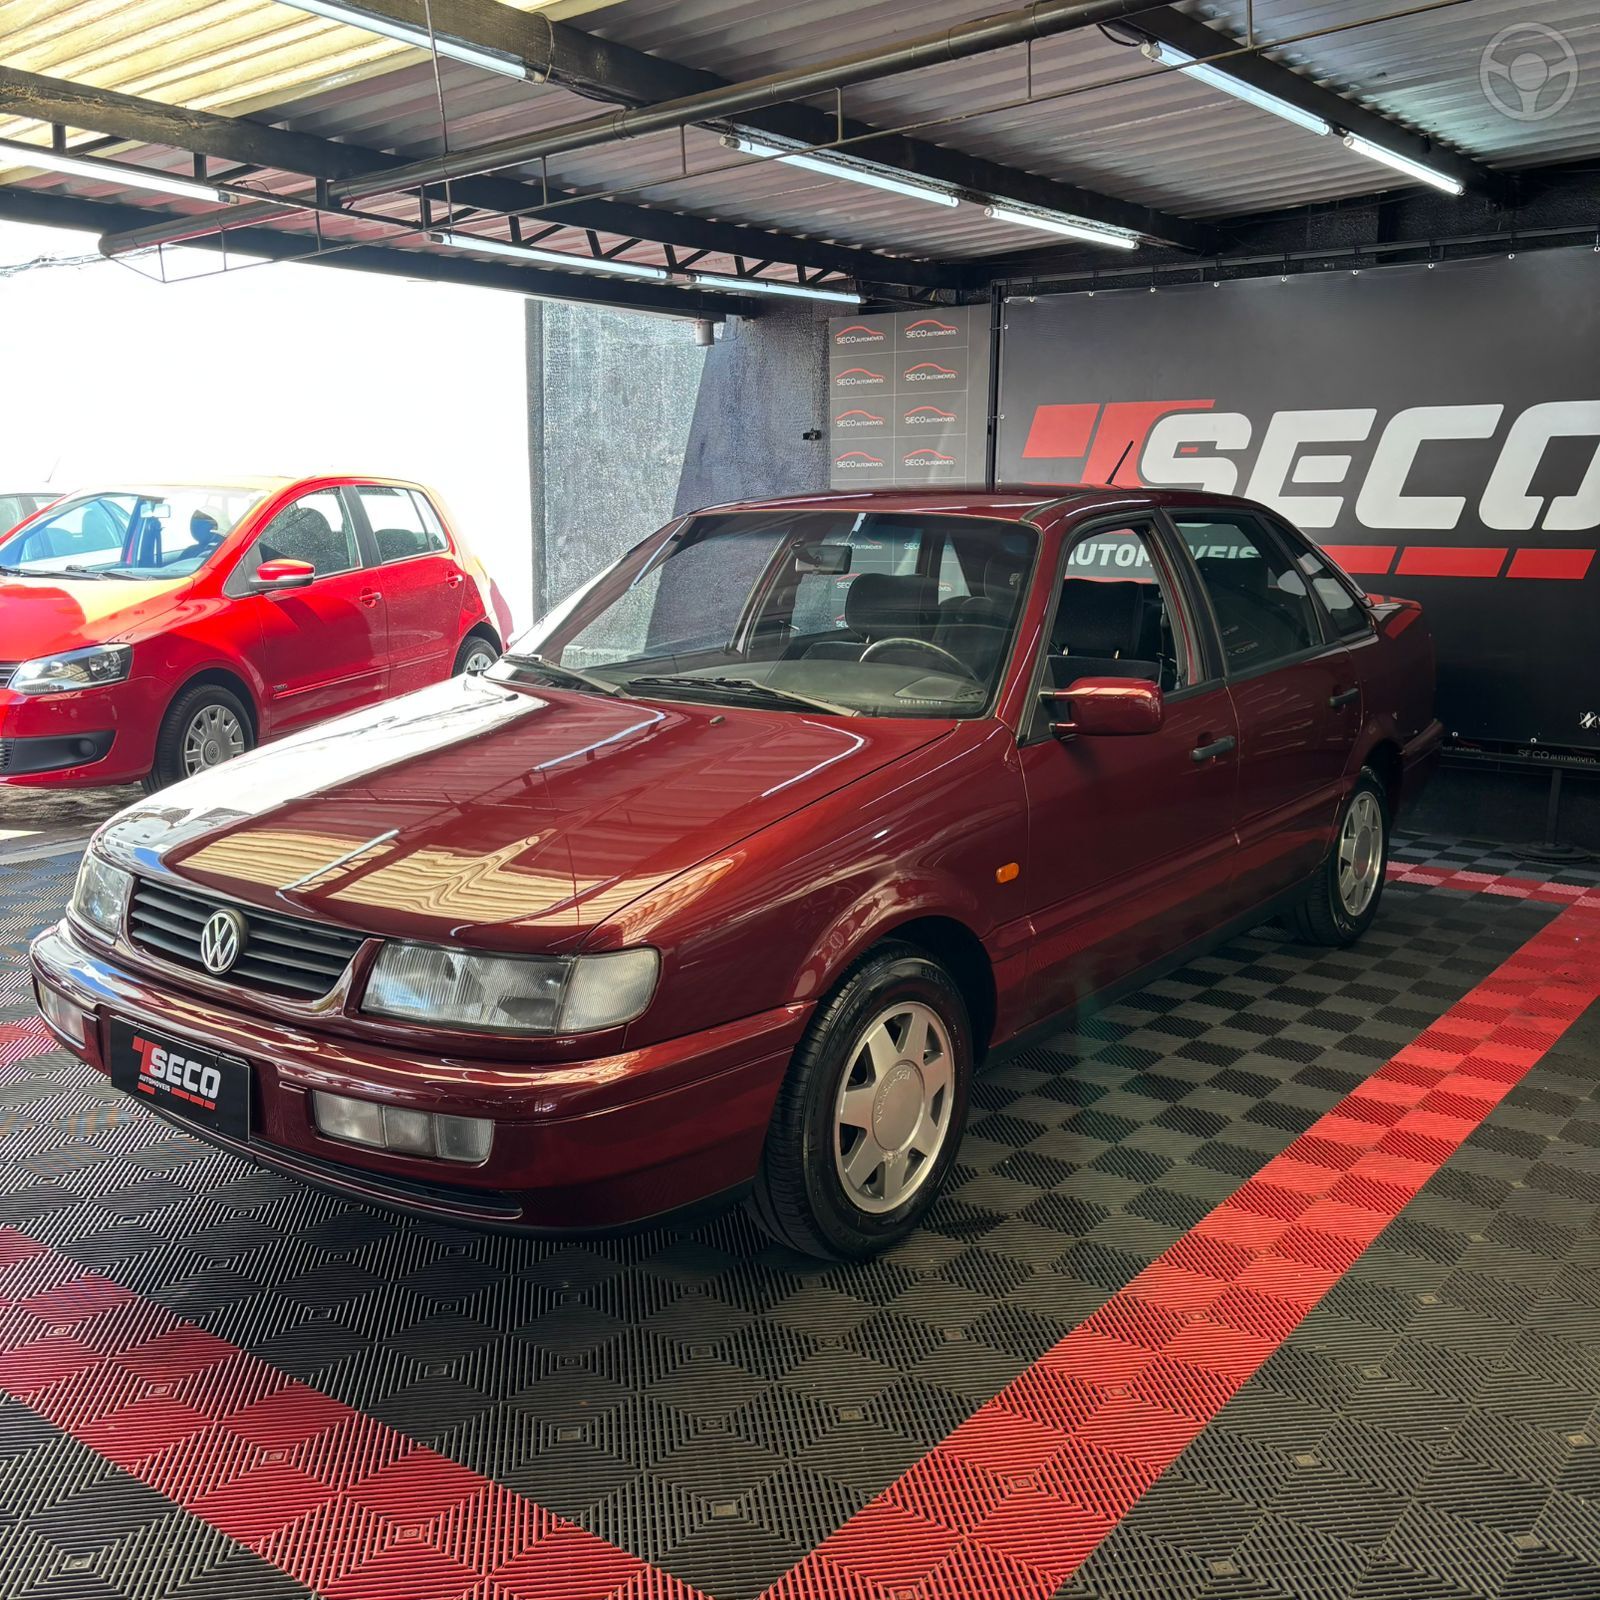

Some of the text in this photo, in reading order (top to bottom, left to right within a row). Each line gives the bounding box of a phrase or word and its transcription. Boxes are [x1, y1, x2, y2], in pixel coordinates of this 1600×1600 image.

[906, 329, 927, 338] SECO
[837, 336, 856, 345] SECO
[837, 377, 856, 386] SECO
[906, 373, 926, 381] SECO
[837, 419, 856, 428] SECO
[905, 415, 925, 424] SECO
[837, 460, 856, 468] SECO
[905, 459, 925, 467] SECO
[1141, 400, 1600, 530] SECO
[1518, 749, 1549, 759] SECO
[149, 1047, 221, 1099] SECO
